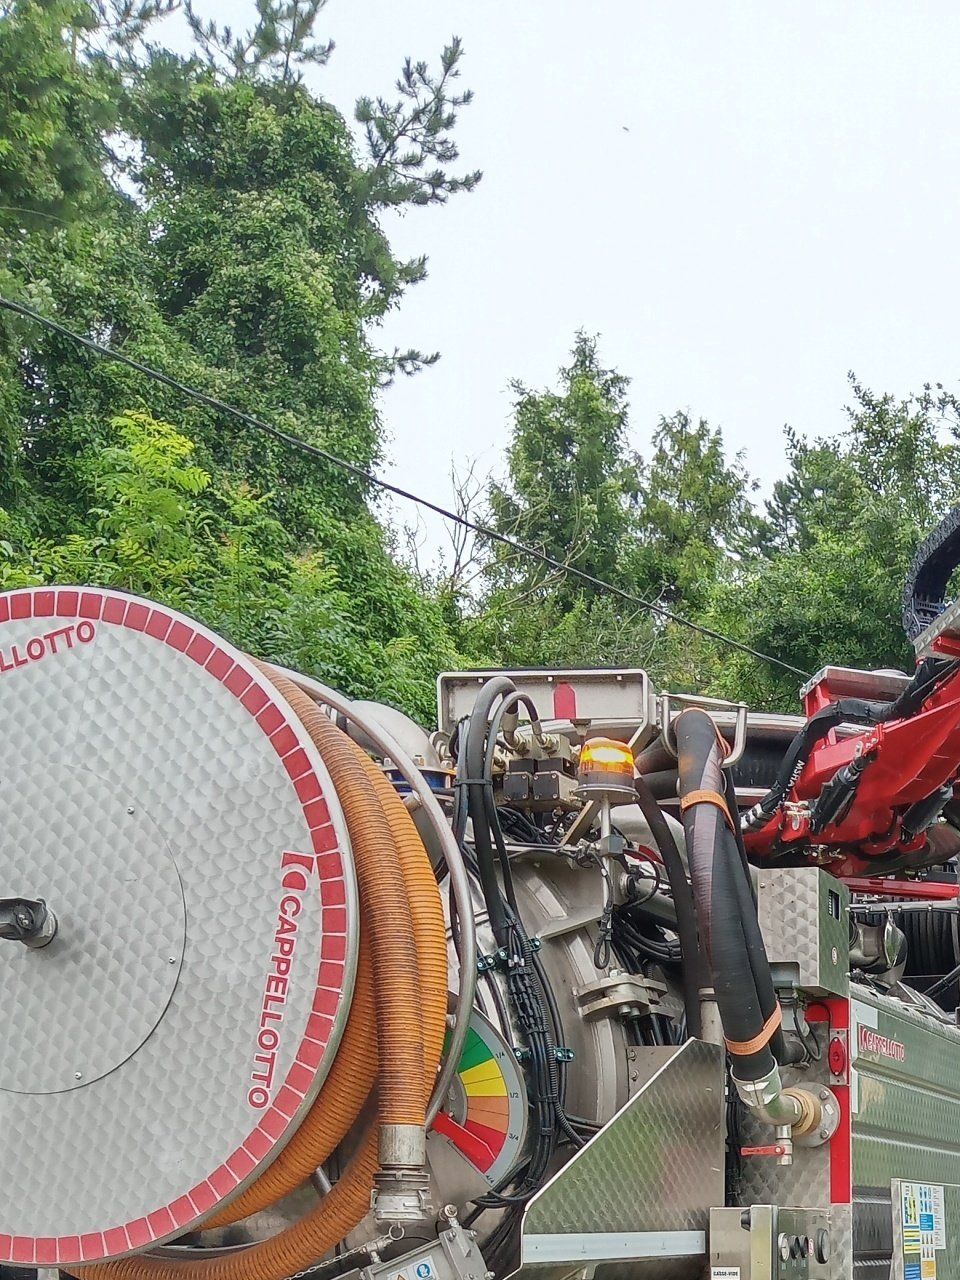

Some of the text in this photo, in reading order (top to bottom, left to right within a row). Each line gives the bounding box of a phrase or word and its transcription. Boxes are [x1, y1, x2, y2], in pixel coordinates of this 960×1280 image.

[788, 760, 805, 787] MSHA
[249, 895, 302, 1109] CAPPELLOTTO
[496, 1051, 506, 1060] 1/4
[509, 1091, 520, 1099] 1/2
[508, 1132, 520, 1141] 3/4
